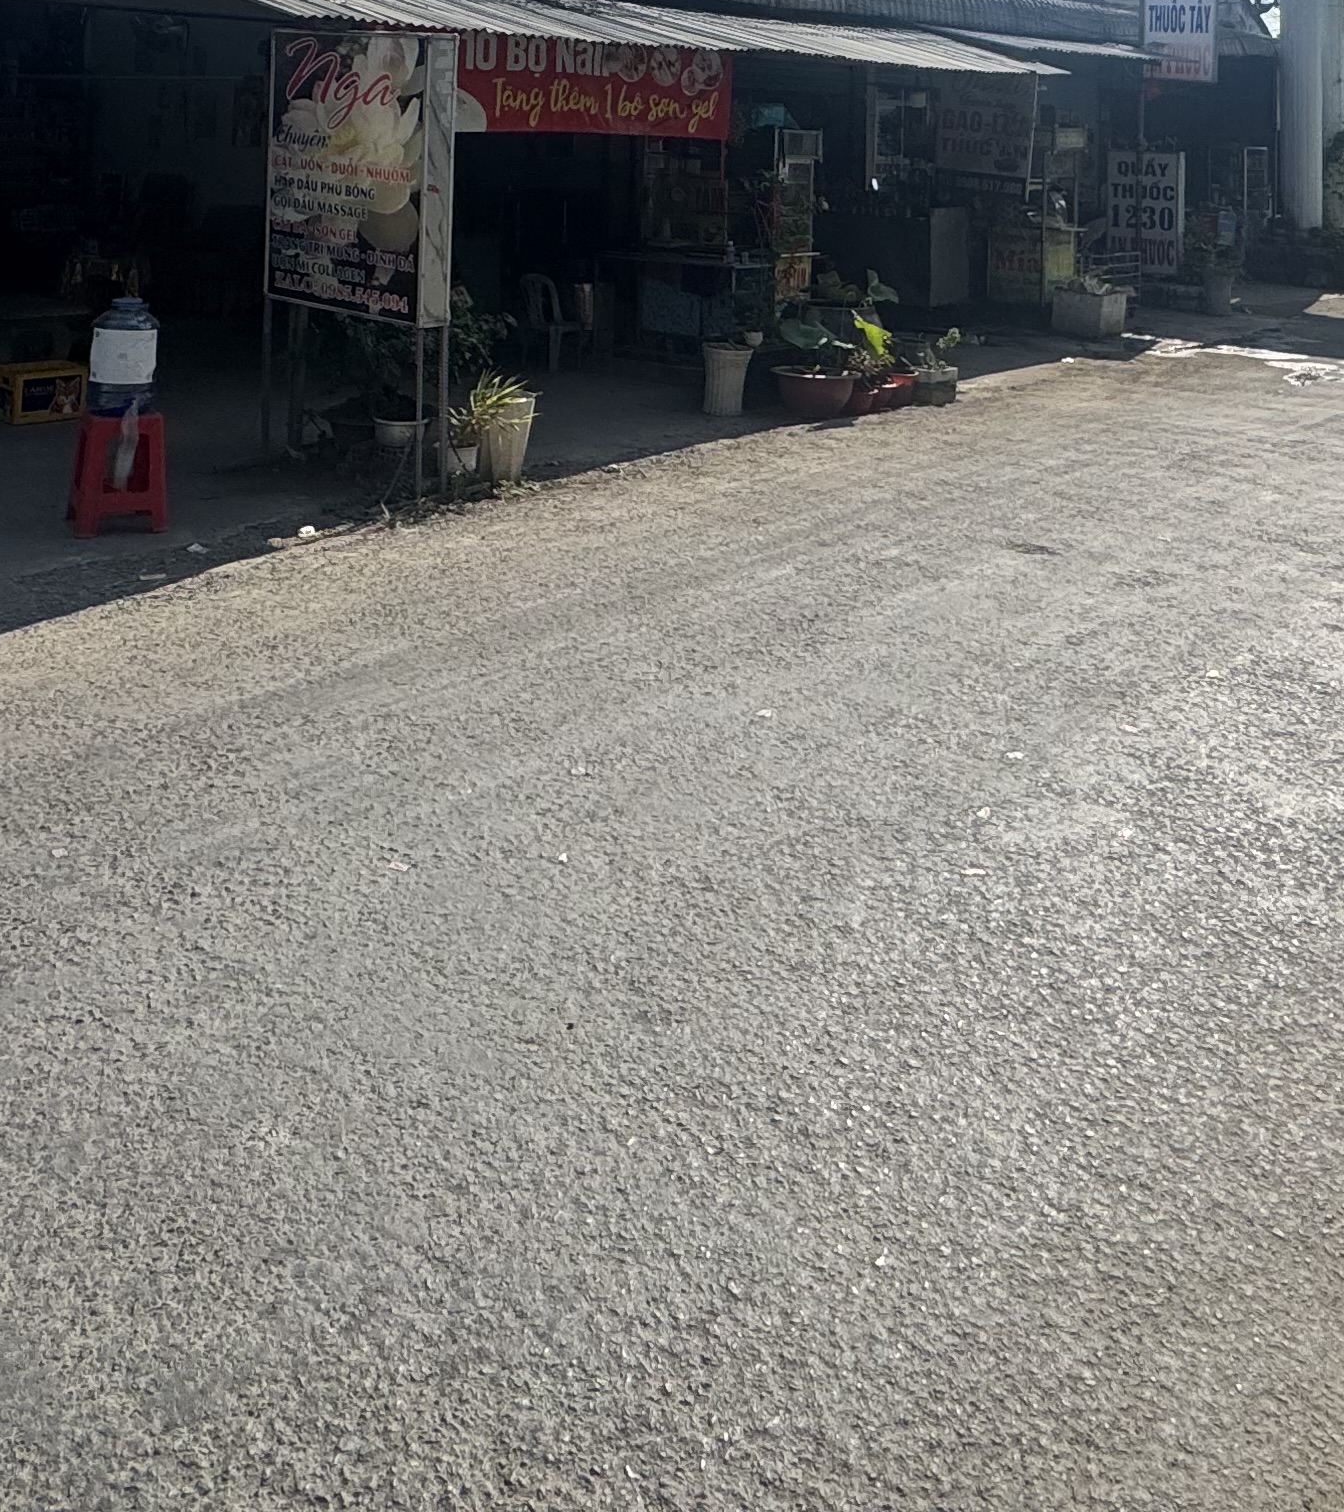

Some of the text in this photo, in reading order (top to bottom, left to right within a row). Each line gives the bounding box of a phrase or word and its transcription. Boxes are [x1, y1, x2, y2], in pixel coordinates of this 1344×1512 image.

[1189, 0, 1212, 34] TÂY
[286, 37, 400, 129] Nga
[492, 78, 545, 126] Tặng
[550, 79, 600, 116] thêm
[618, 85, 646, 120] bộ
[648, 94, 687, 122] sơn
[688, 91, 719, 133] gel
[317, 200, 368, 220] MASSAGE
[1111, 203, 1175, 232] 1230
